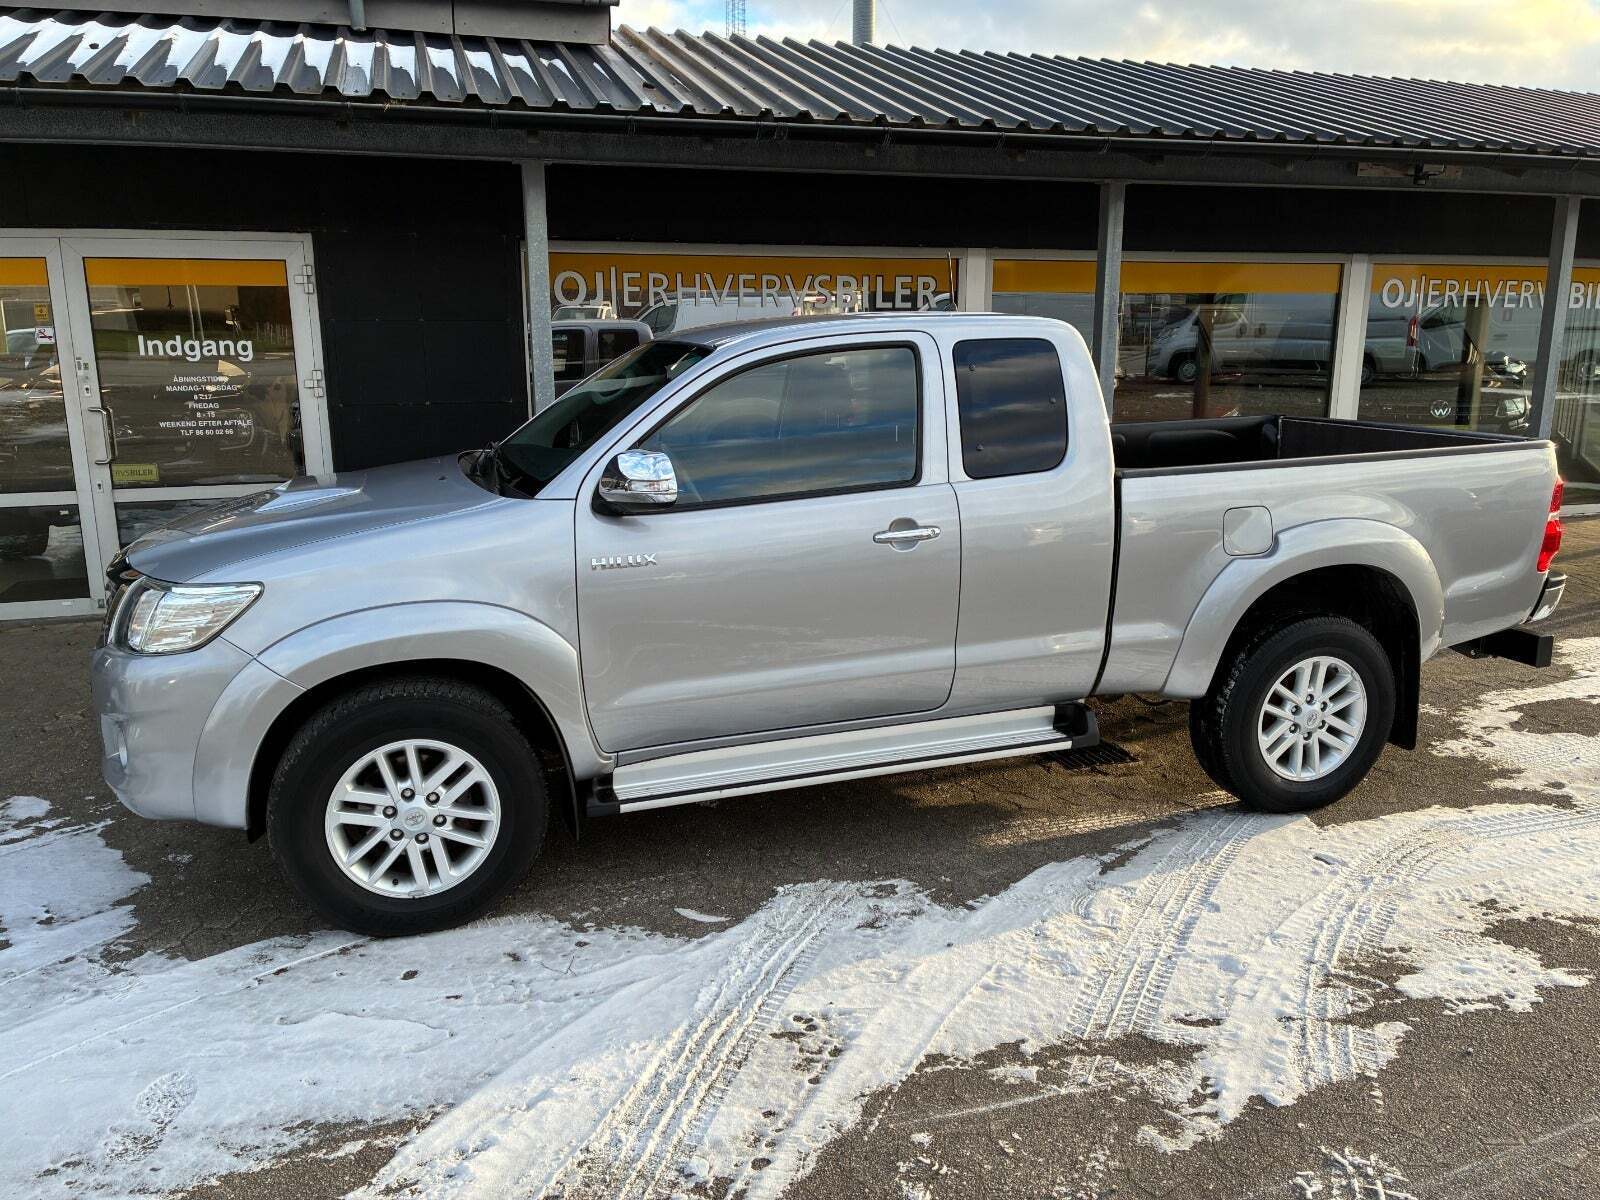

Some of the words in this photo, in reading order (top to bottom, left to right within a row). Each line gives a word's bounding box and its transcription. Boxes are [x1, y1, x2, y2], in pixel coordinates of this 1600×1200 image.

[137, 335, 254, 362] Indgang
[173, 374, 229, 383] ÅBNINGSTID
[591, 553, 657, 569] HILUX
